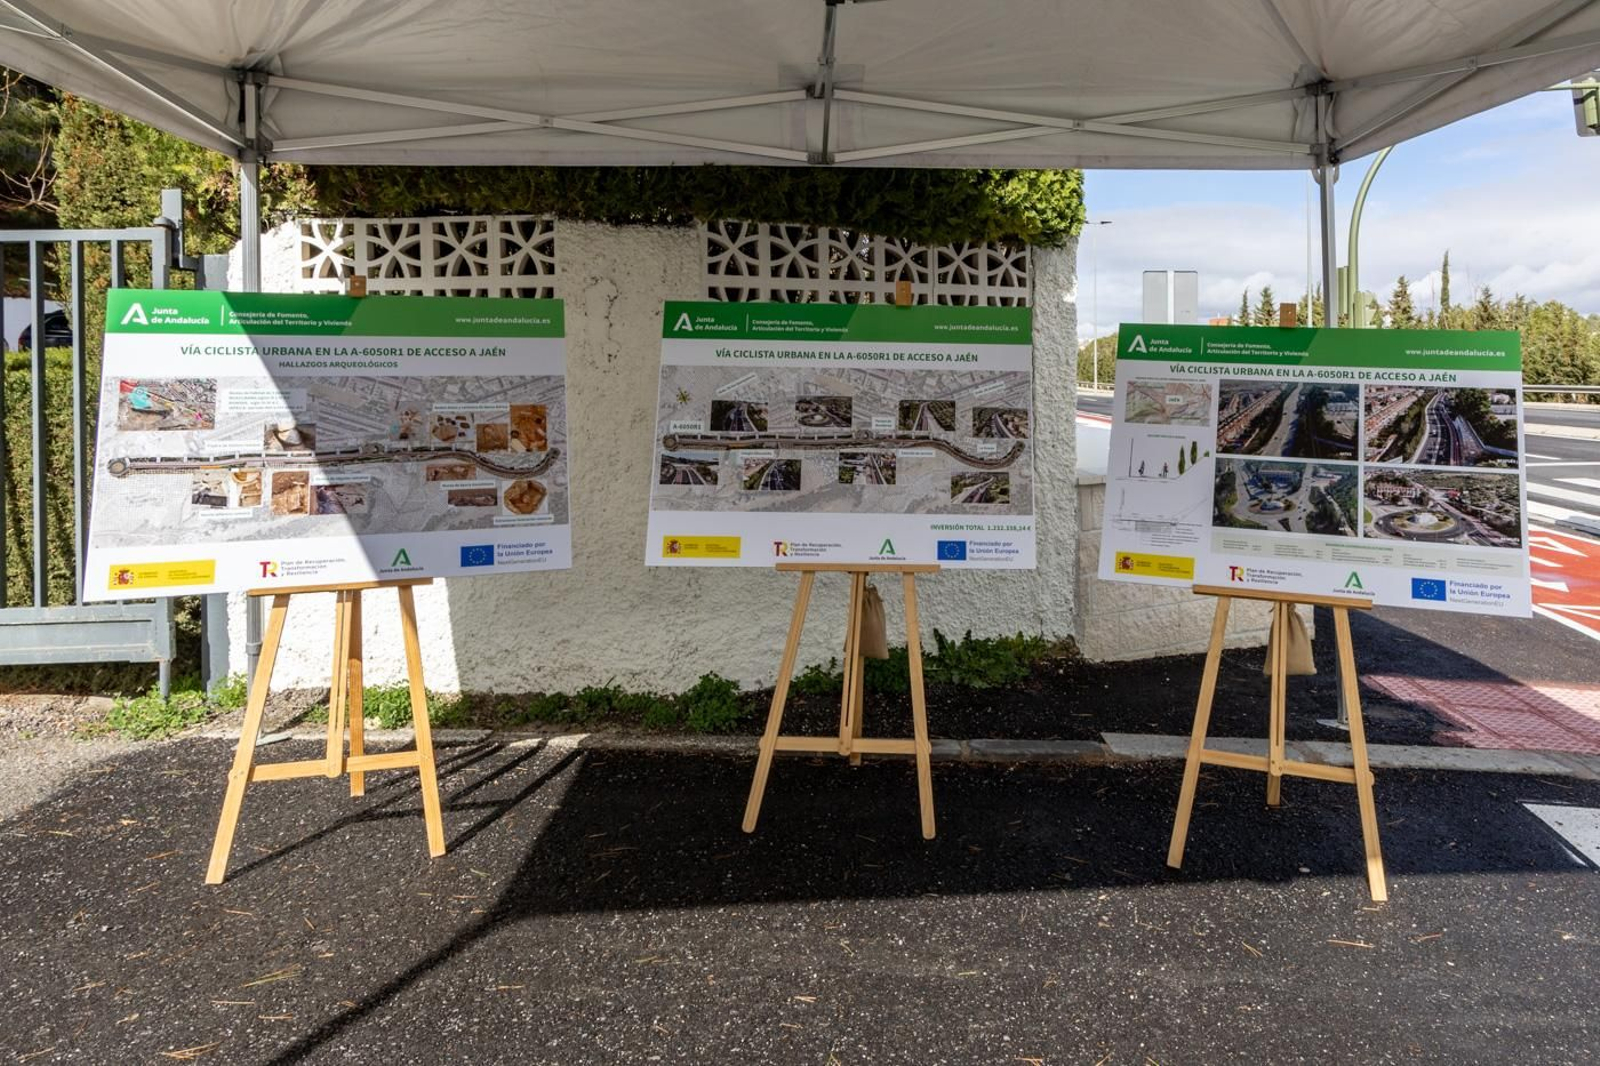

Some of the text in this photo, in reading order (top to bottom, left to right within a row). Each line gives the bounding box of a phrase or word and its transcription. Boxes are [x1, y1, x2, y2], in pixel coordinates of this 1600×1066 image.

[152, 307, 178, 315] Junta
[164, 316, 210, 324] Andalucía
[181, 343, 506, 356] VÍA CICLISTA URBANA EN LA A-6050R1 DE ACCESO A JAÉN
[1159, 346, 1192, 354] Andalucía
[716, 347, 978, 362] VÍA CICLISTA URBANA EN LA A-6050R1 DE ACCESO A JAÉN
[329, 360, 398, 368] ARQUEOLÓGICOS
[1169, 363, 1457, 382] VÍA CICLISTA URBANA EN LA A-6050R1 DE ACCESO A JAÉN
